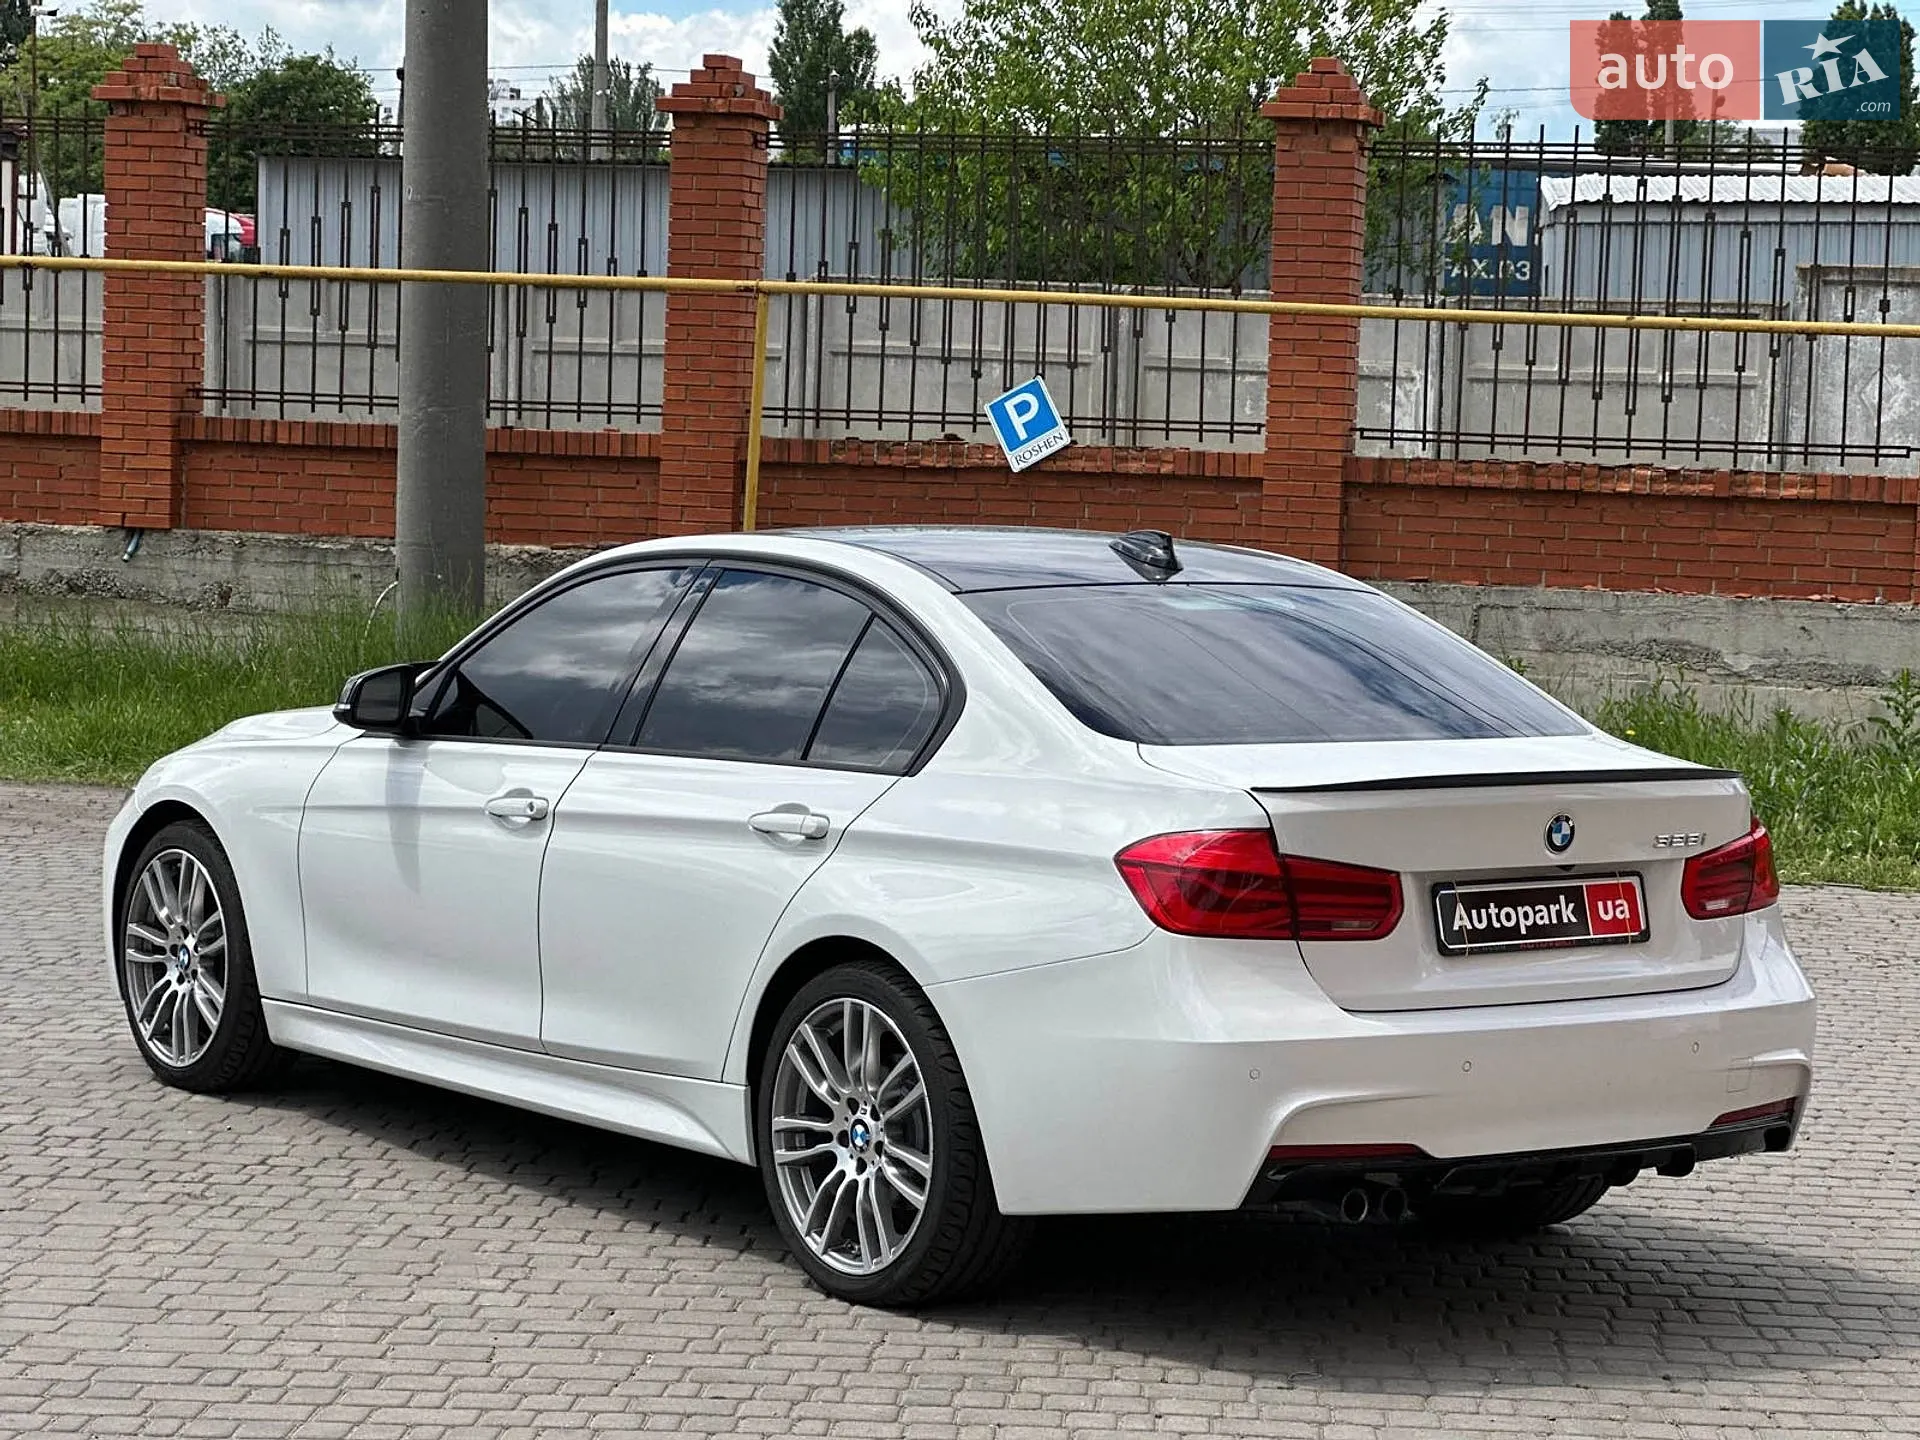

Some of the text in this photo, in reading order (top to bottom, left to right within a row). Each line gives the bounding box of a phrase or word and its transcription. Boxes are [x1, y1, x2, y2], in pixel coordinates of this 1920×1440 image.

[1004, 393, 1039, 441] P
[1014, 433, 1064, 466] ROSHEN
[1453, 894, 1631, 935] Autopark ua
